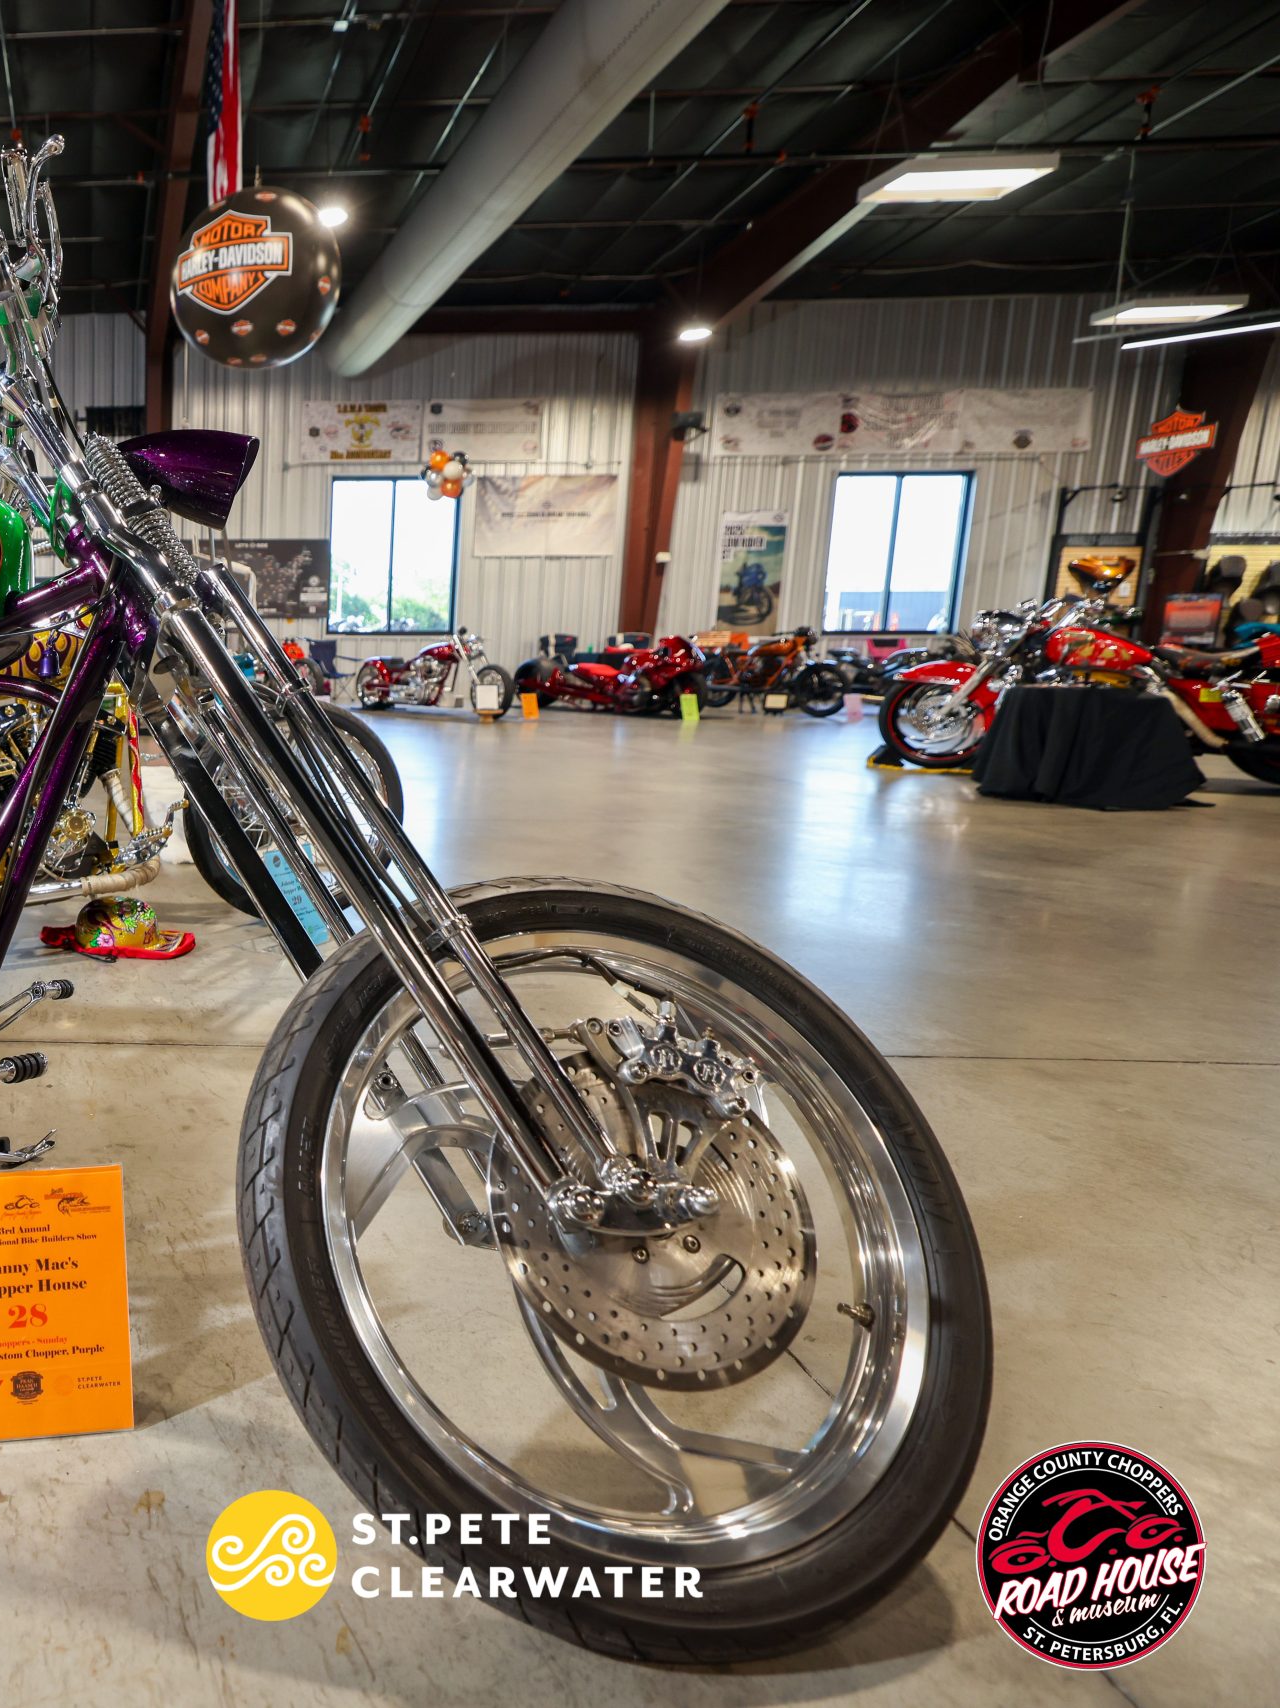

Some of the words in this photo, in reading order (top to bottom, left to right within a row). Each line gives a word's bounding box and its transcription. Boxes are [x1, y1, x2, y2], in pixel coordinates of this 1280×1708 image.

[200, 220, 259, 245] MOTOR
[181, 242, 283, 282] HARLEY-DAVIDSON
[199, 271, 256, 304] COMPANY
[19, 1224, 50, 1233] Annual
[21, 1236, 39, 1245] Bike
[41, 1234, 75, 1243] Builders
[76, 1232, 97, 1241] Show
[35, 1257, 79, 1272] Mac's
[38, 1278, 88, 1292] House
[8, 1303, 48, 1329] 28
[37, 1336, 68, 1345] Sunday
[25, 1347, 69, 1358] Chopper,
[72, 1344, 105, 1355] Purple
[77, 1380, 121, 1390] CLEARWATER
